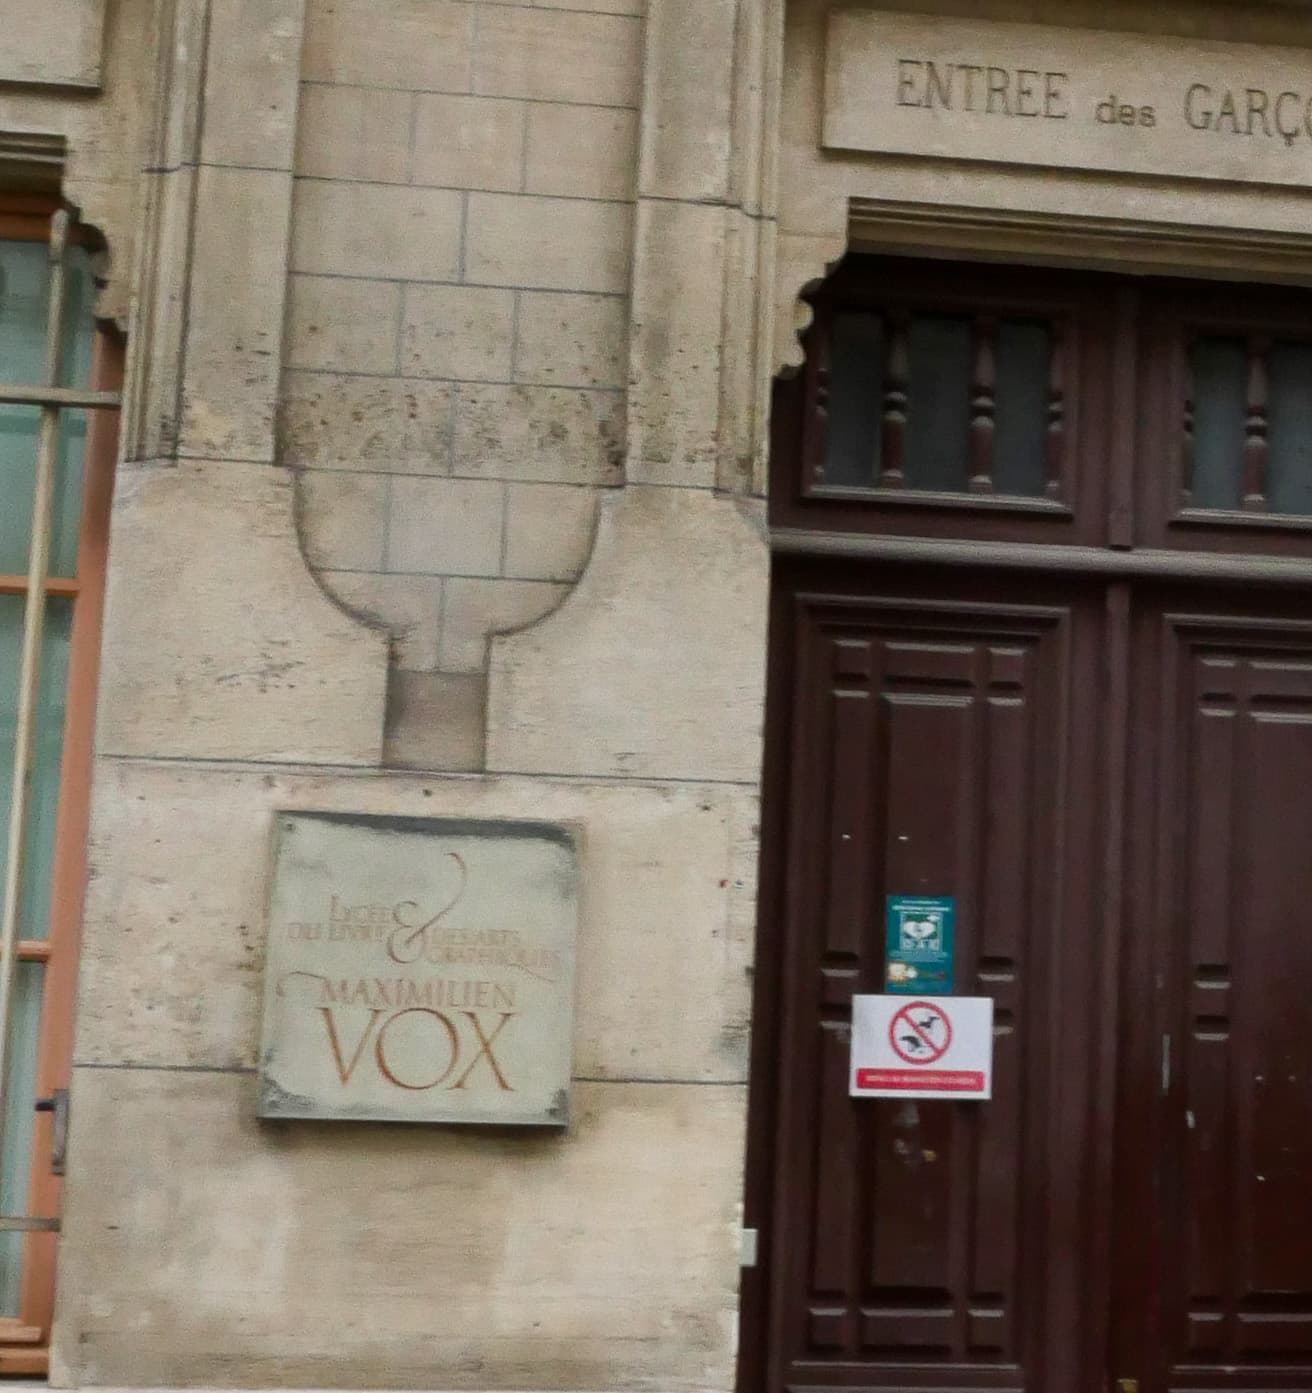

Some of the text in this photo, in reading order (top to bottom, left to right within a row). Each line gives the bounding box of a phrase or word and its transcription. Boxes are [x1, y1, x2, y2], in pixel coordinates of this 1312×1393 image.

[896, 58, 1069, 119] ENTREE
[1095, 94, 1156, 127] des
[278, 972, 516, 1009] MAXIMILIEN
[315, 1007, 518, 1091] VOX
